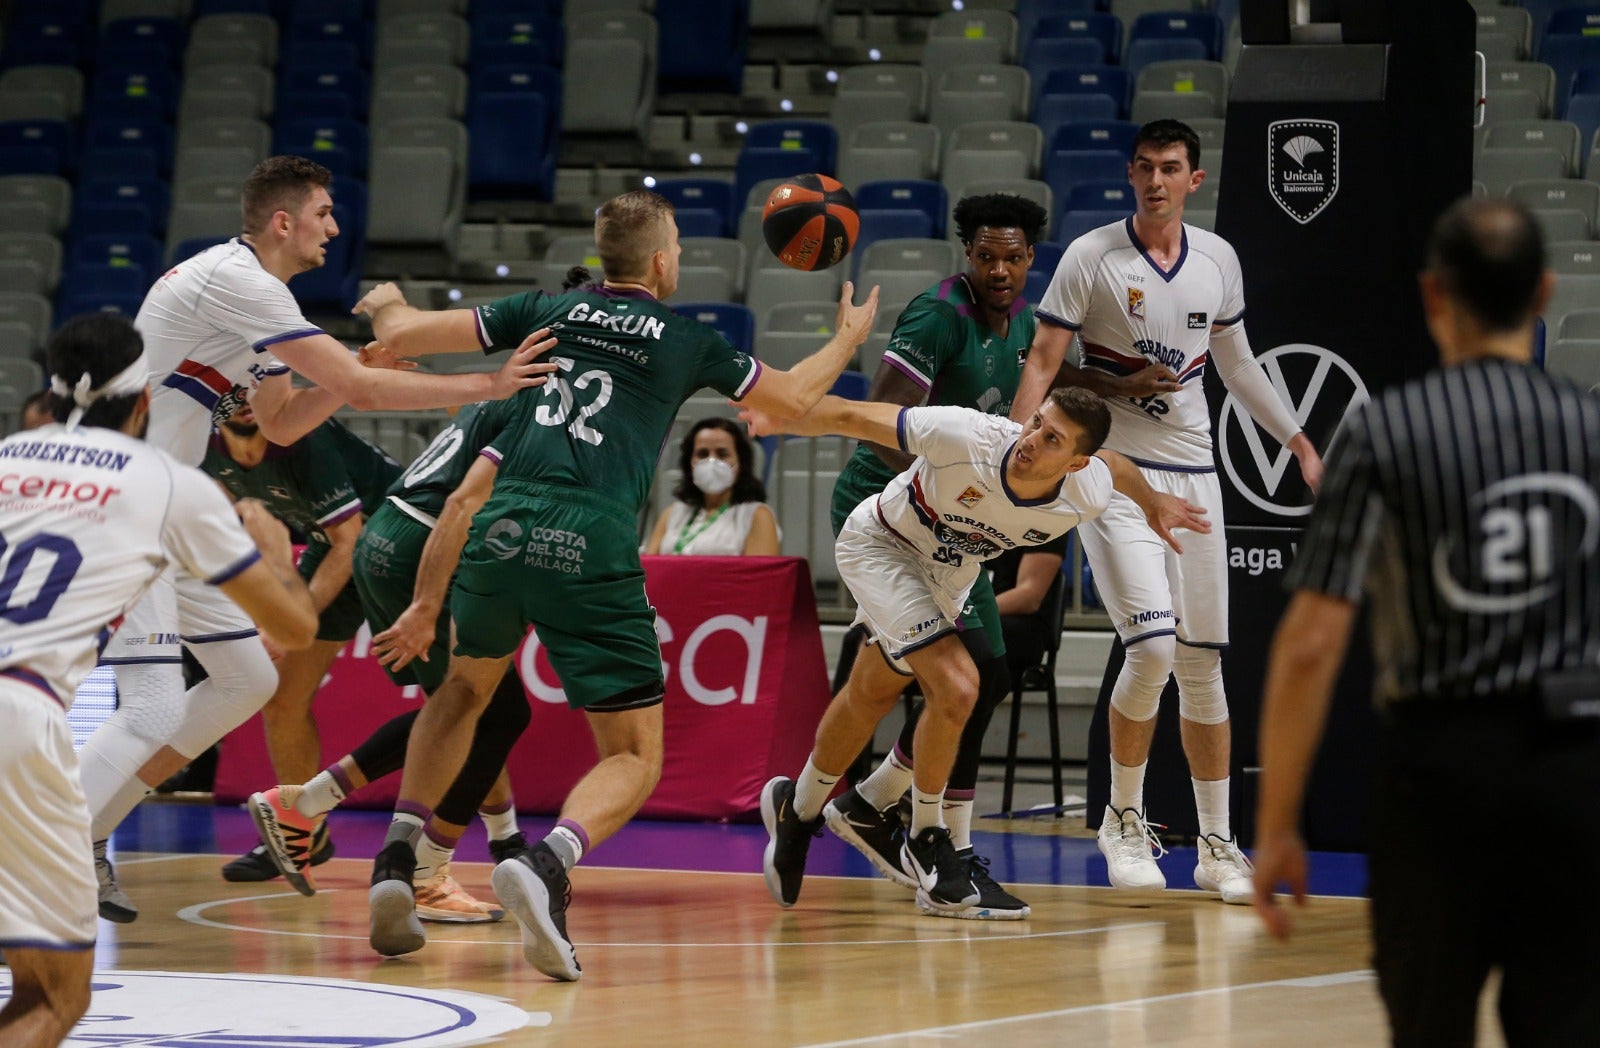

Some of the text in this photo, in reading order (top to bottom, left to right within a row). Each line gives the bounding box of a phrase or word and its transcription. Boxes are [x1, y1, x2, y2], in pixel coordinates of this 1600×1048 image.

[1283, 169, 1323, 183] Unicaja
[1127, 273, 1145, 284] GEFF
[567, 302, 666, 340] GERUN
[535, 356, 613, 447] 52
[0, 441, 132, 473] ROBERTSON
[526, 541, 585, 563] DEL SOL
[531, 527, 588, 550] COSTA
[1480, 504, 1551, 584] 21
[0, 530, 83, 626] 0
[525, 555, 582, 575] MÁLAGA
